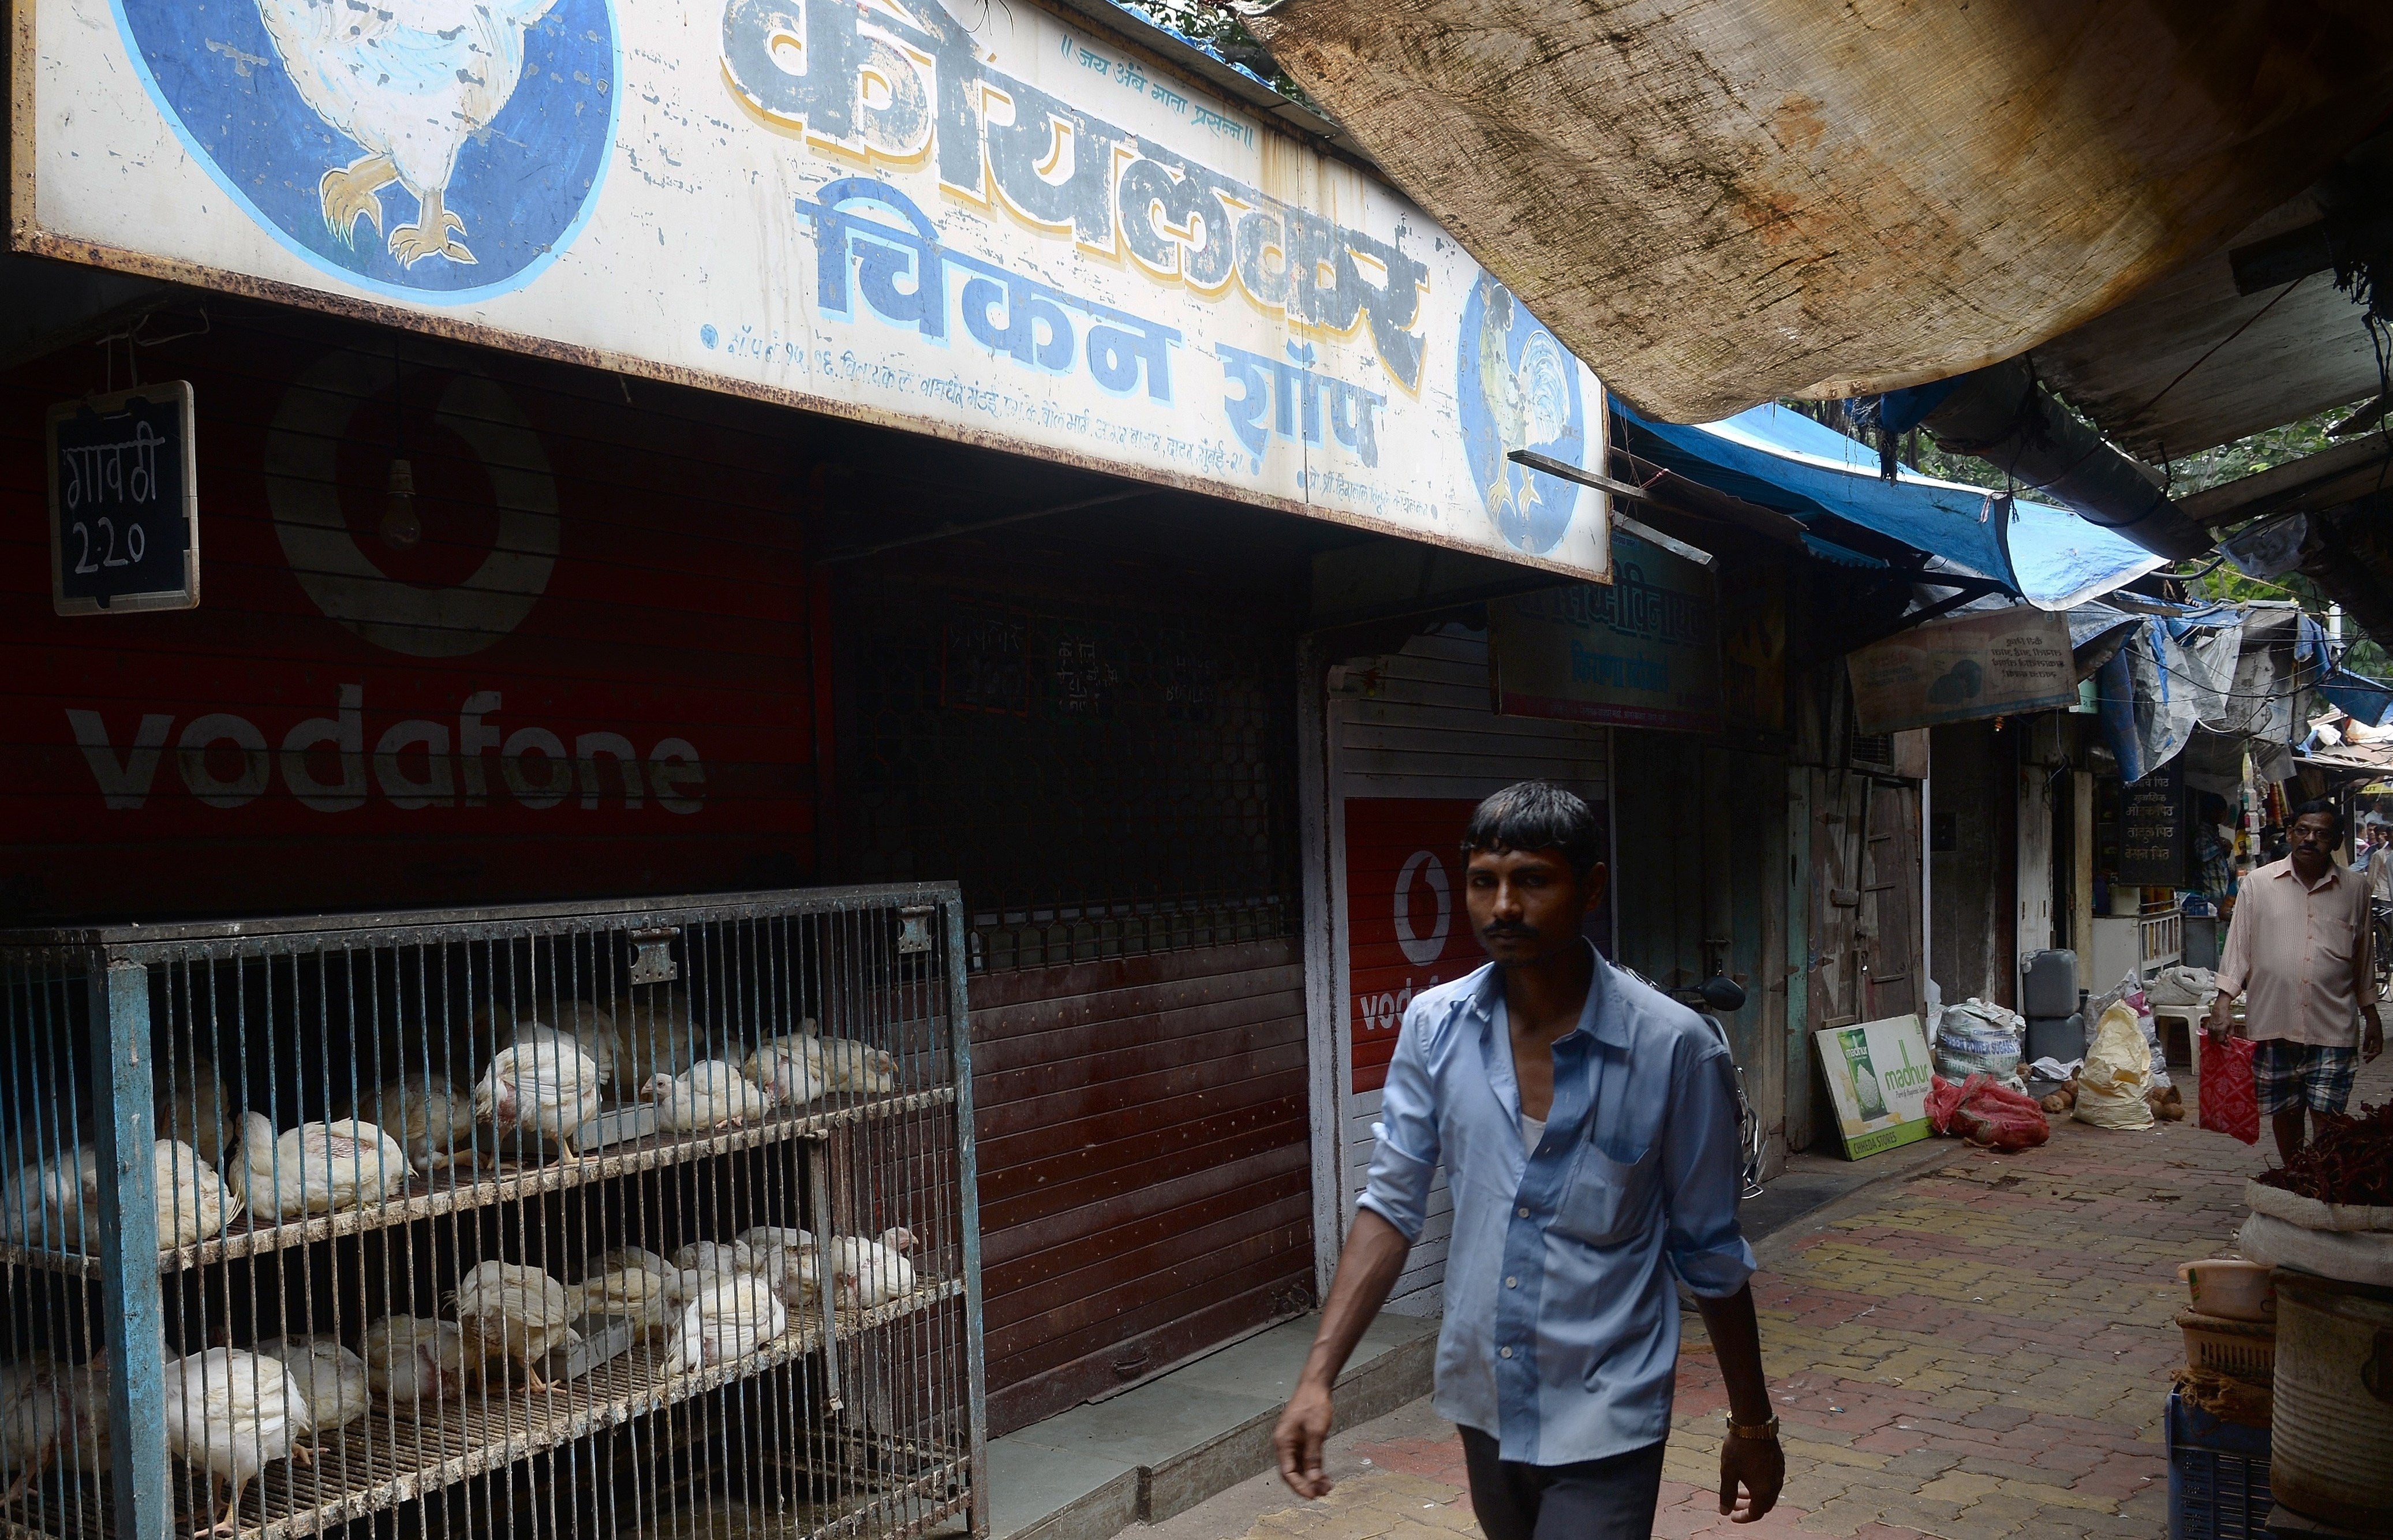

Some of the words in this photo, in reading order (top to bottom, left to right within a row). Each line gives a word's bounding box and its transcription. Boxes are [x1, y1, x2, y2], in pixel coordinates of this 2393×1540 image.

[795, 177, 1182, 407] चिकन
[1215, 339, 1388, 468] शॉप
[62, 420, 165, 509] गावठी
[65, 684, 706, 814] vodafone
[1885, 1039, 1929, 1090] madhur
[1853, 1138, 1878, 1154] CHHEDA
[1878, 1131, 1897, 1147] STORES
